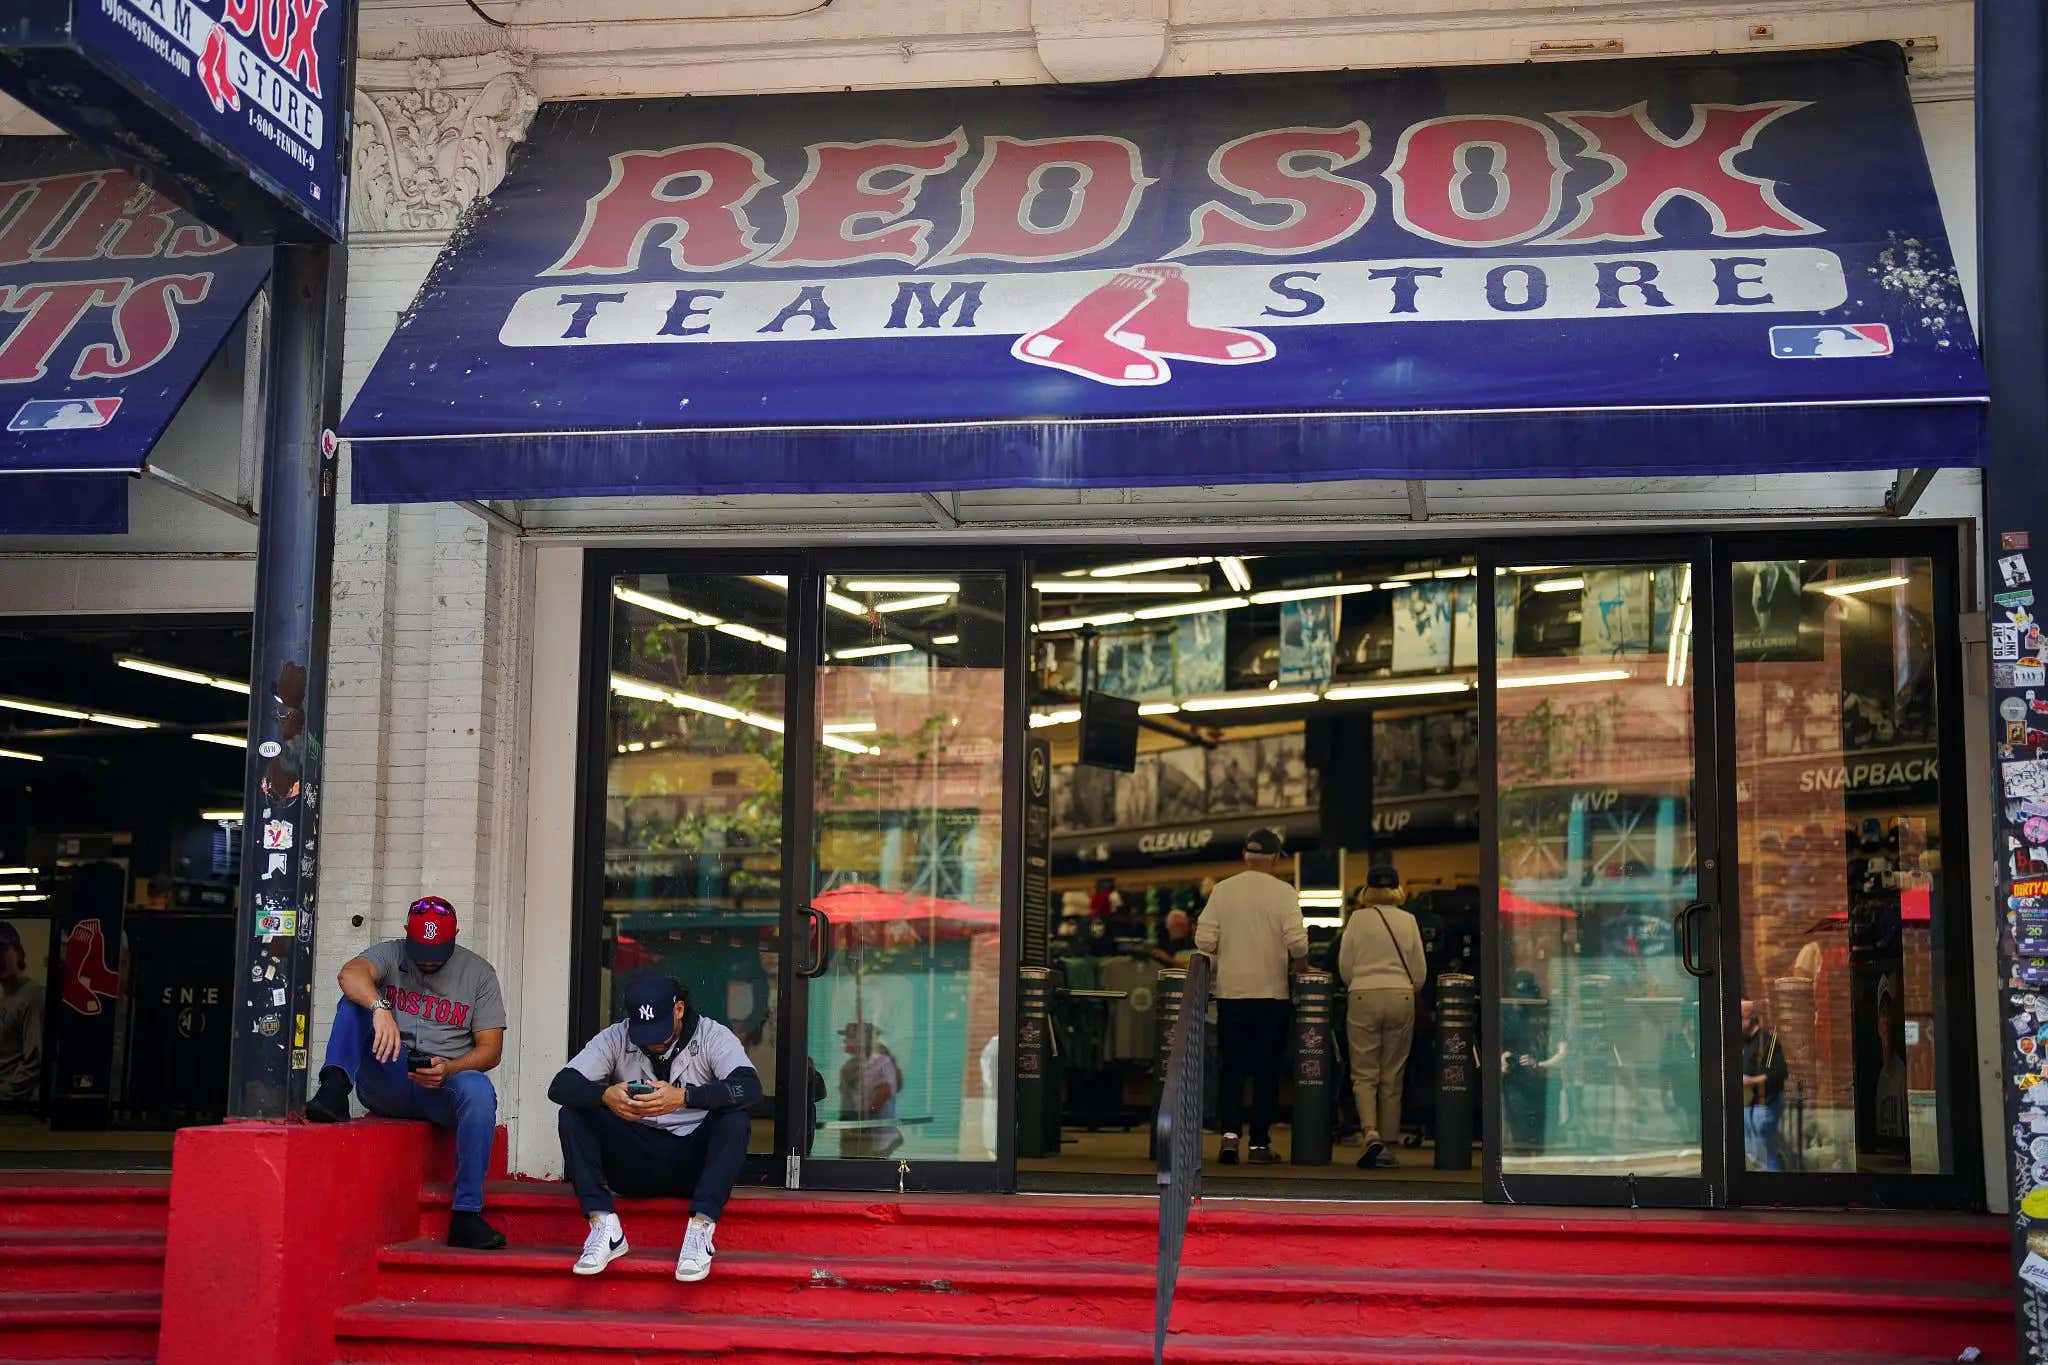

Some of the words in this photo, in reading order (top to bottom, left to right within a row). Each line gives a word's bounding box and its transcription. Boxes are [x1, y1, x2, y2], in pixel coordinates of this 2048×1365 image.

[238, 50, 314, 140] STORE
[248, 108, 315, 172] 1-800-FENWAY-9
[536, 126, 1159, 277] RED
[1157, 99, 1825, 261] SOX
[556, 280, 988, 339] TEAM
[1261, 255, 1776, 318] STORE
[1799, 759, 1939, 793] SNAPBACK
[1571, 788, 1619, 813] MVP
[1138, 832, 1188, 854] CLEAN
[1189, 828, 1214, 849] UP
[423, 921, 438, 940] B
[385, 984, 471, 1029] BOSTON
[638, 1004, 655, 1021] NY
